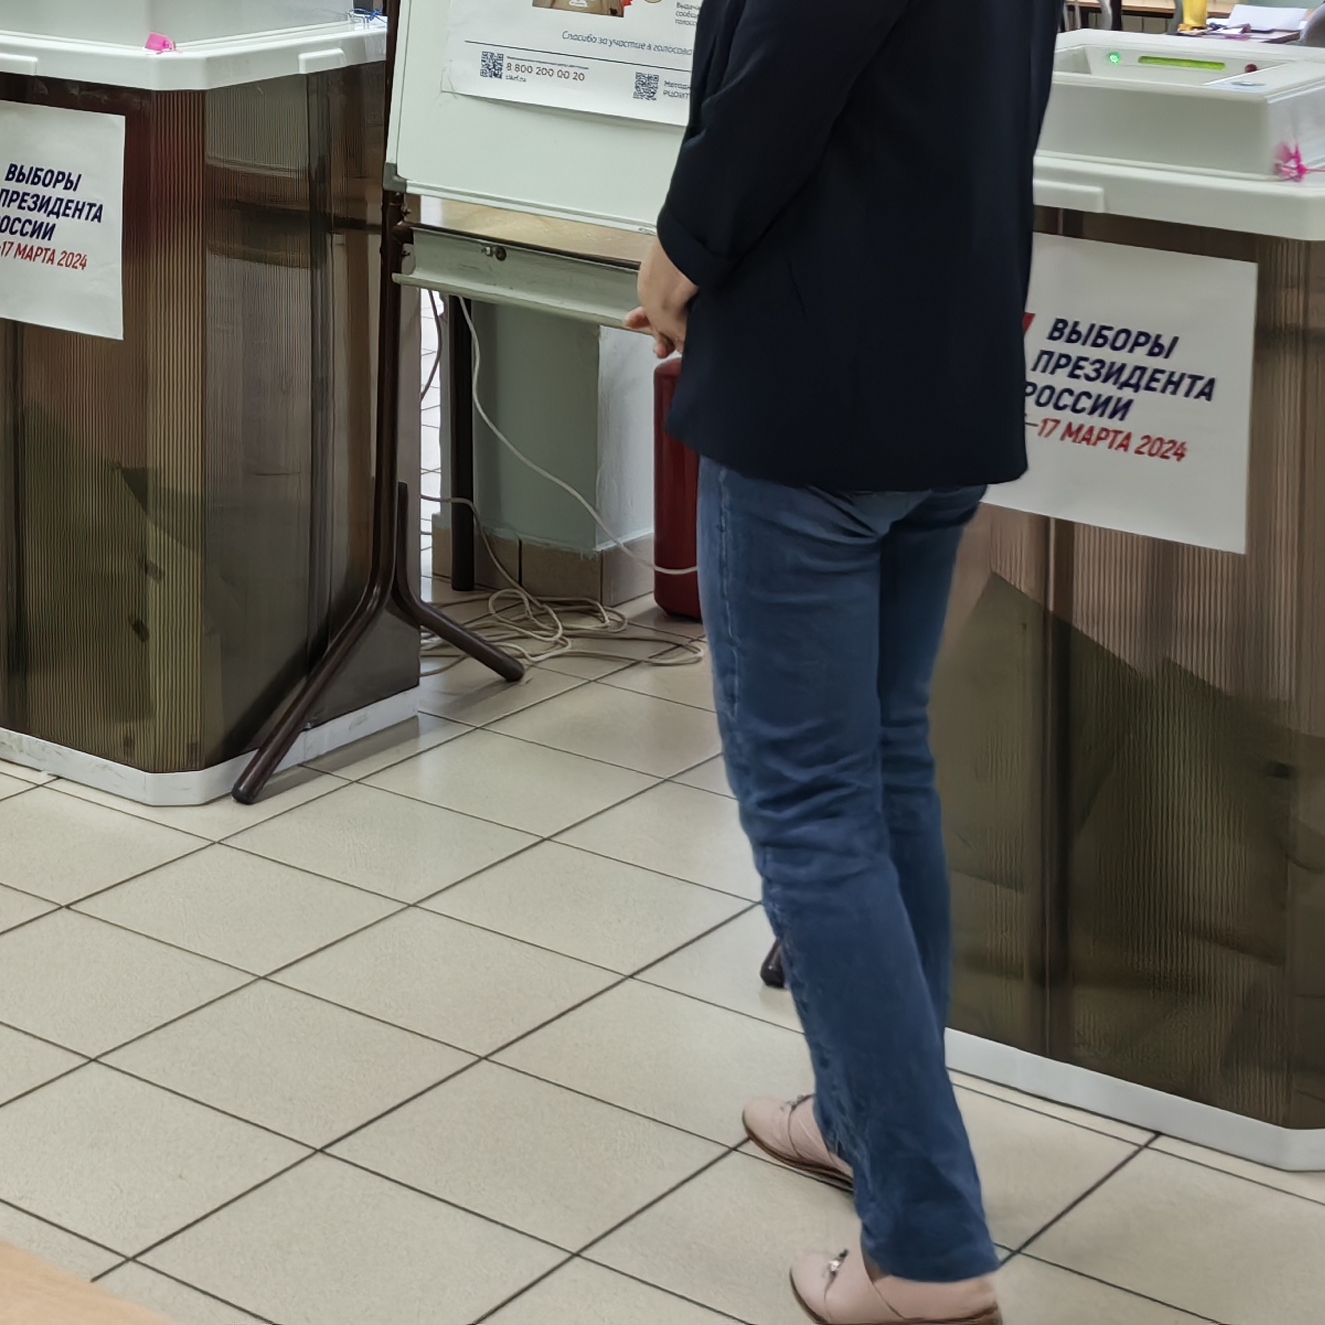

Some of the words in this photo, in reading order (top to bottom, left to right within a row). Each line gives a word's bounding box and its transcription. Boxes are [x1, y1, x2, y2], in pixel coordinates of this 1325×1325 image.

[506, 62, 512, 71] 8
[536, 67, 554, 77] 200
[556, 69, 570, 79] 00
[572, 71, 585, 81] 20
[5, 163, 82, 192] ВЫБОРЫ
[14, 242, 56, 265] МАРТА
[58, 250, 88, 271] 2024
[1046, 317, 1180, 359] ВЫБОРЫ
[1030, 349, 1217, 403] ПРЕЗИДЕНТА
[1024, 381, 1134, 422] РОССИИ
[1060, 421, 1132, 454] МАРТА
[1134, 435, 1188, 463] 2024
